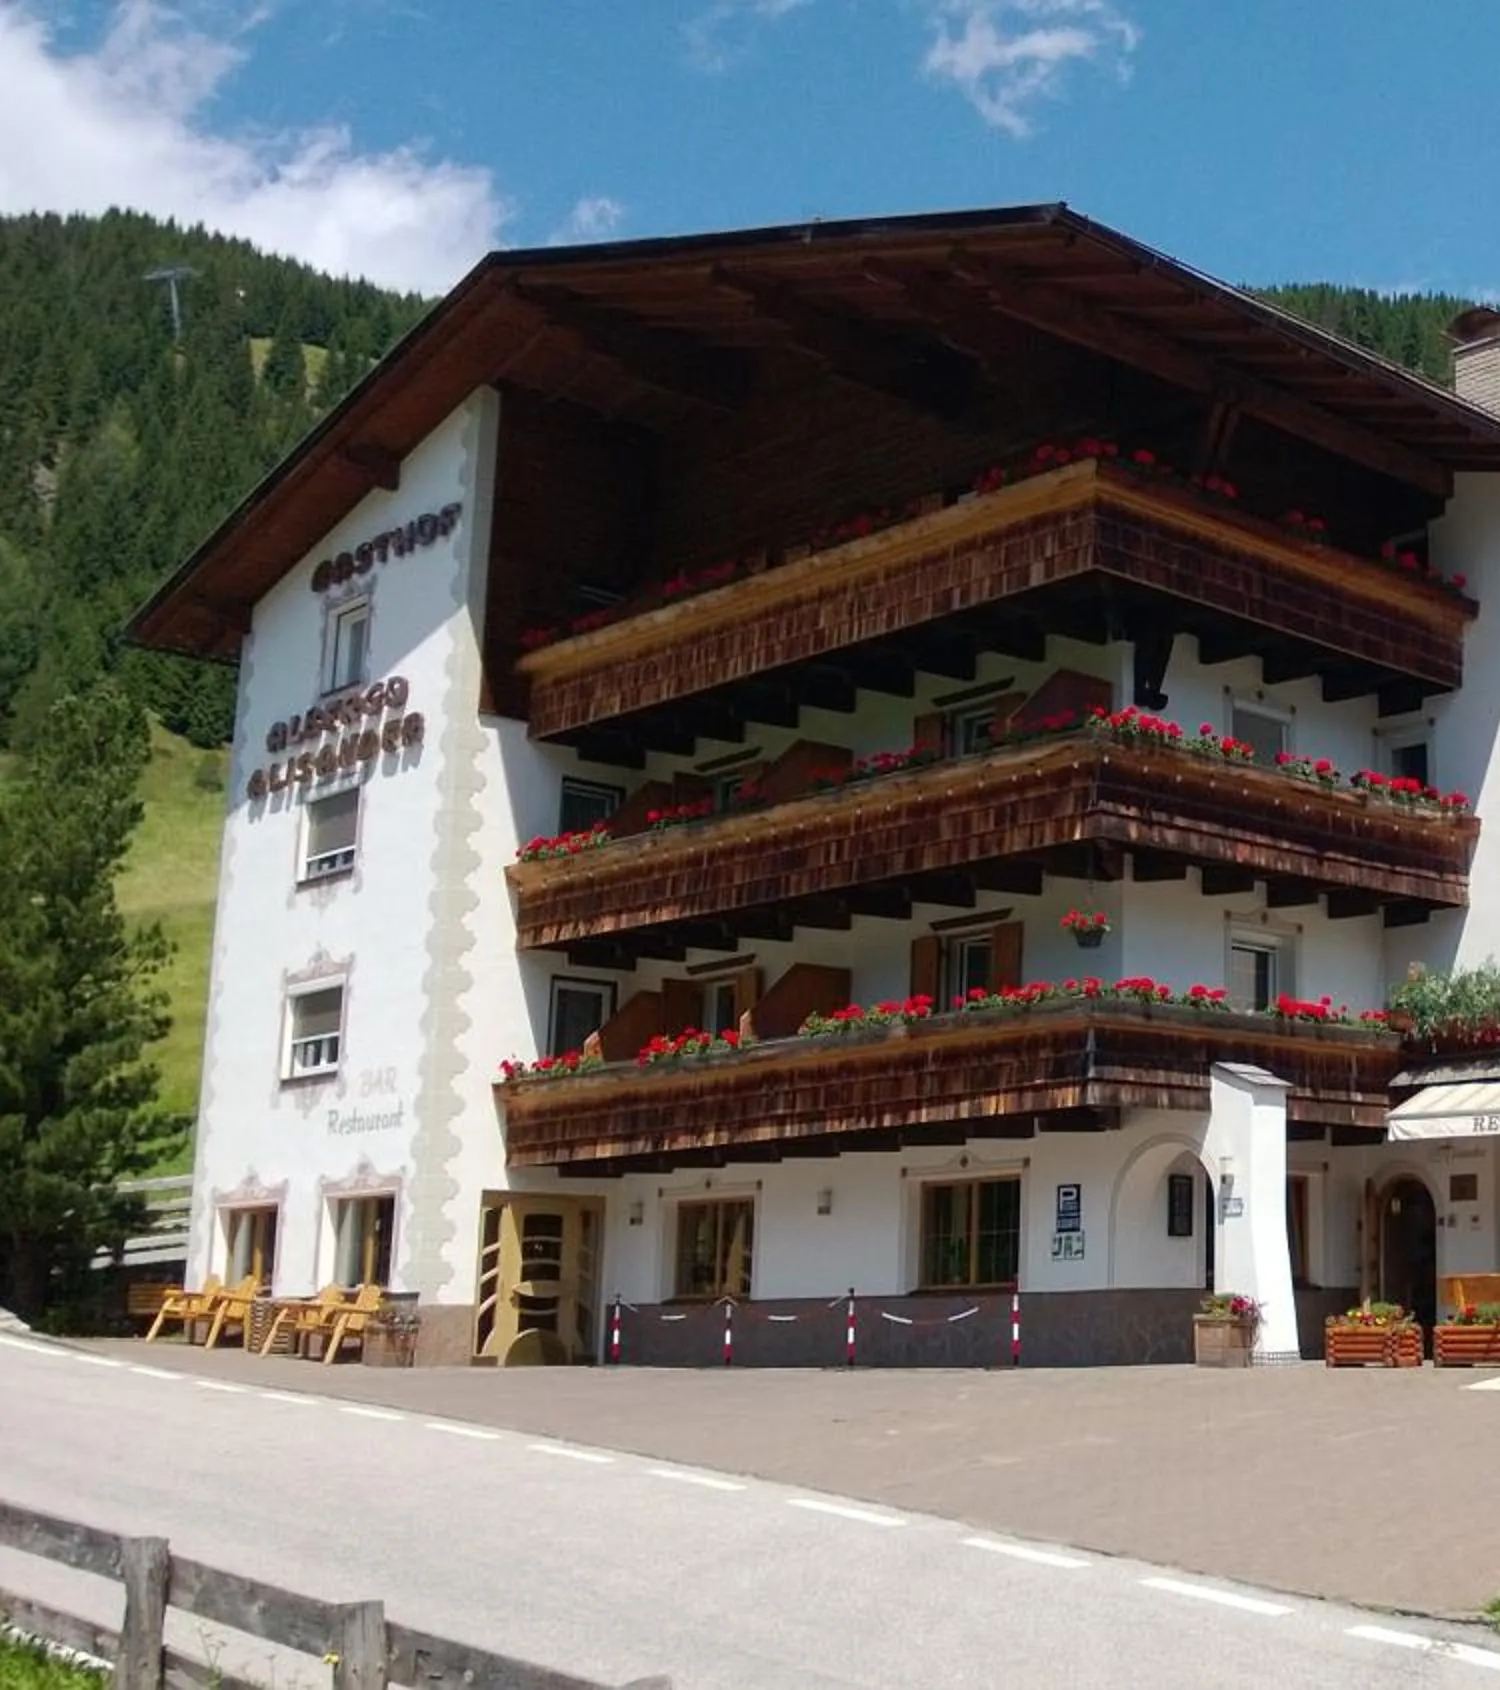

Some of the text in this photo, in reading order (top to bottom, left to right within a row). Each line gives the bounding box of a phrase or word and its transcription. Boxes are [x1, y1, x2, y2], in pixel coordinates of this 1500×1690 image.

[311, 502, 463, 592] GASTHOF
[266, 675, 409, 753] ALBERGO
[358, 1066, 398, 1098] BAR
[327, 1099, 405, 1136] Restaurant
